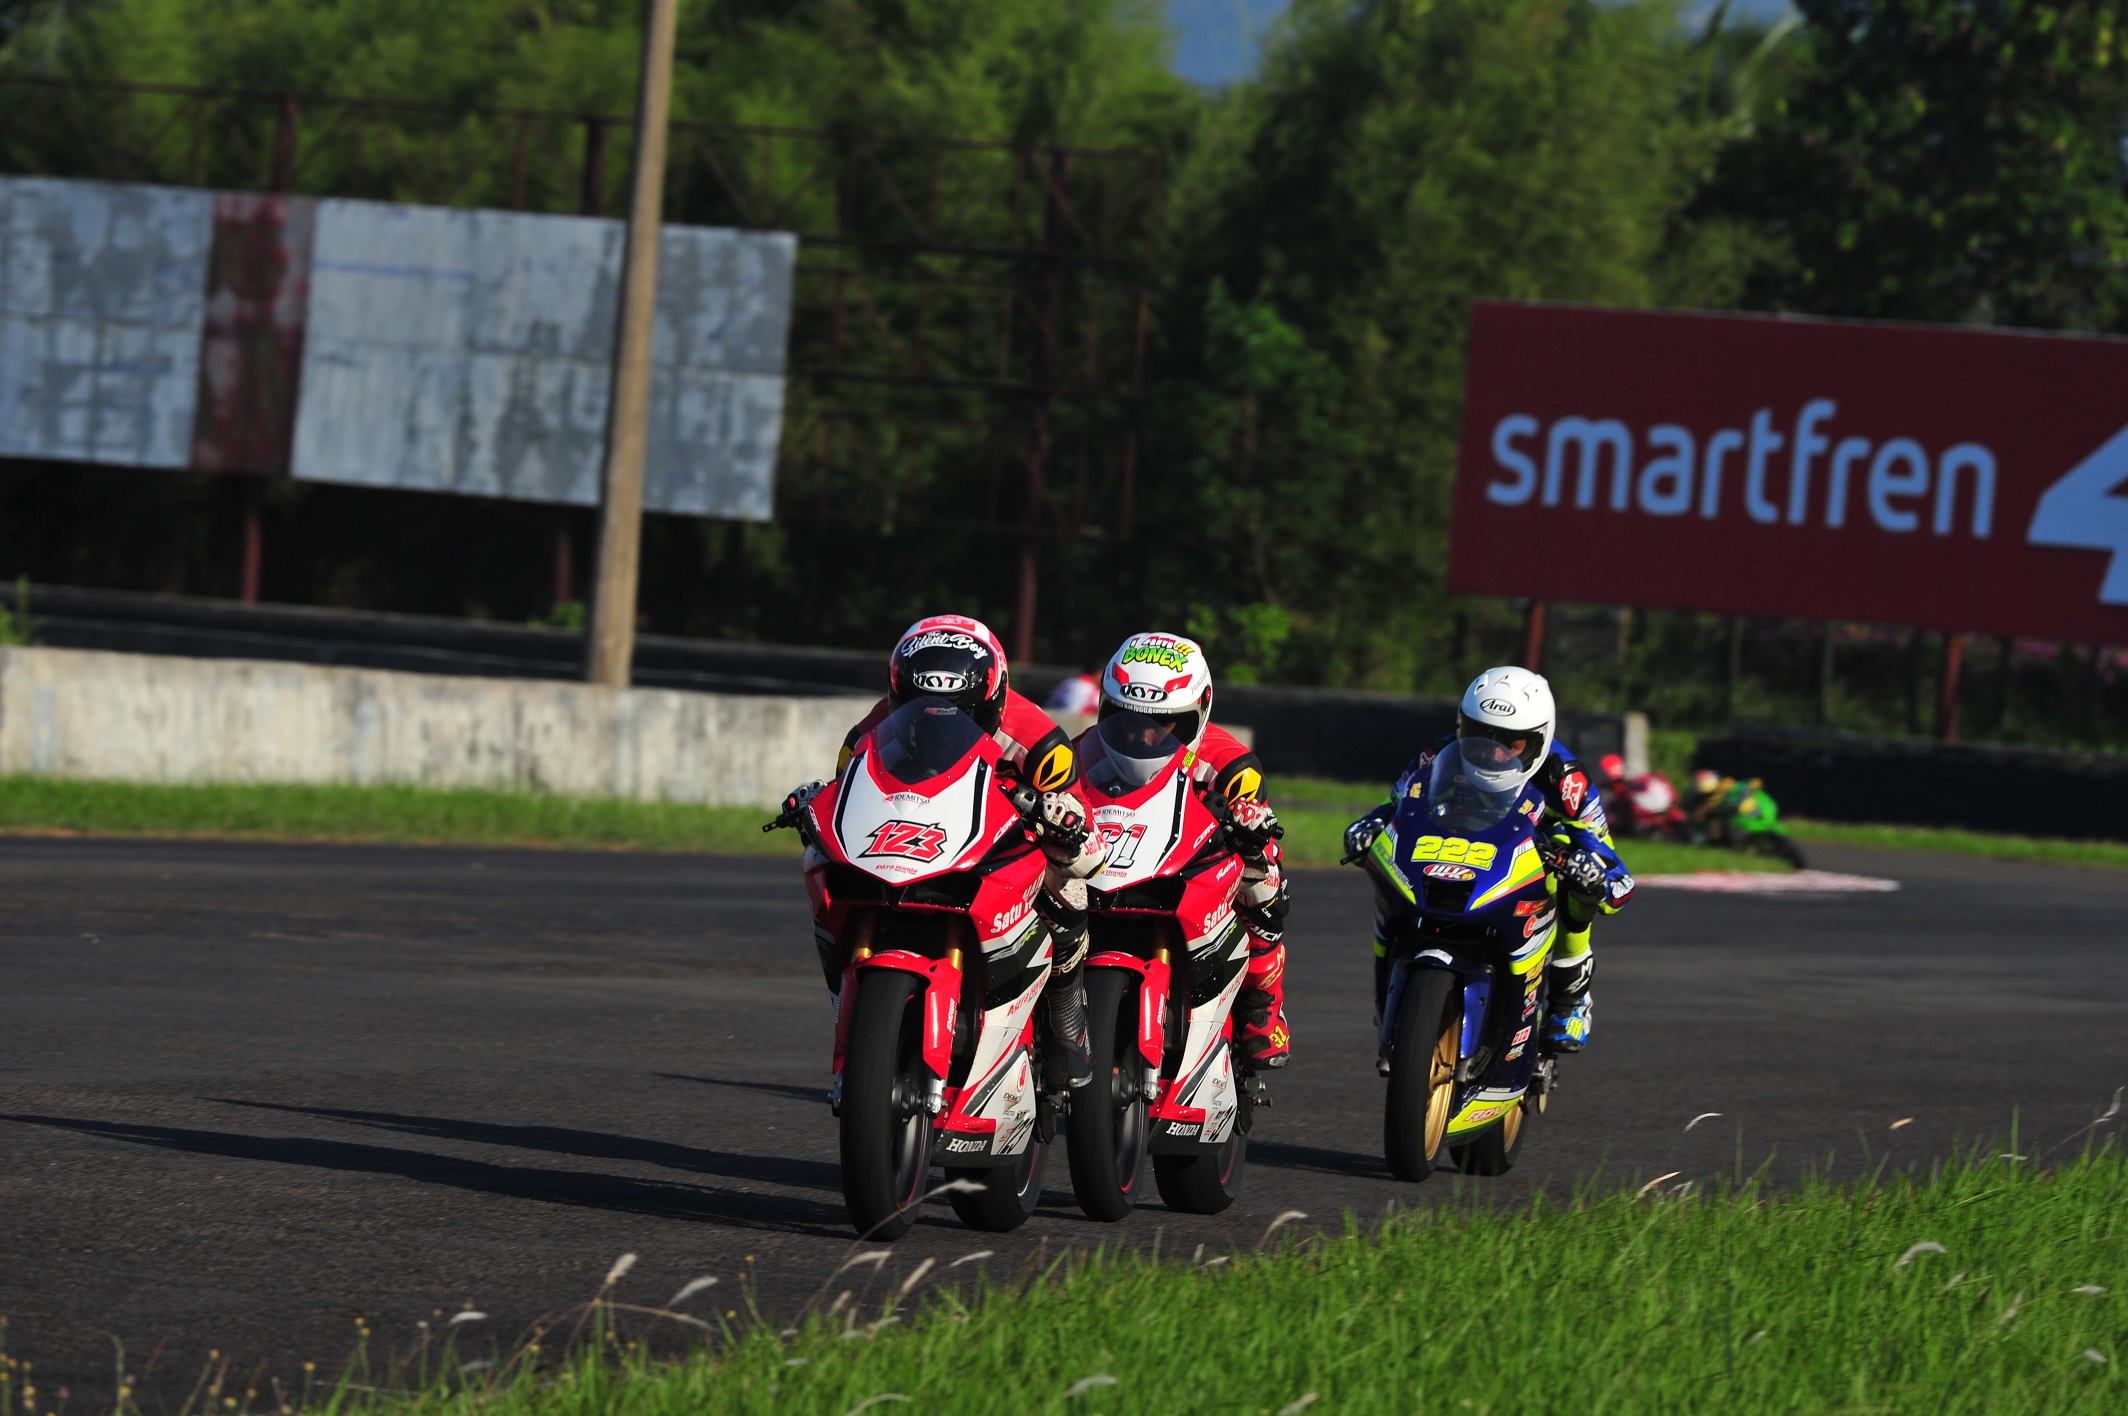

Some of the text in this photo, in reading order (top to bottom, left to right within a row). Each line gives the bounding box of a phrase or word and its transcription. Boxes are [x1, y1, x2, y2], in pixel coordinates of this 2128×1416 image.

[1487, 399, 1997, 538] smartfren
[950, 633, 988, 660] Boy
[1121, 646, 1188, 673] BONEX
[919, 676, 959, 689] KYT
[1127, 686, 1161, 700] KYT
[1485, 700, 1512, 713] Arai
[894, 793, 931, 805] IDEMITSU
[1102, 808, 1135, 818] IDEMITSU
[993, 814, 1018, 843] CBR
[1193, 822, 1216, 849] CBR
[861, 820, 946, 863] 123
[1411, 836, 1497, 871] 222
[895, 864, 918, 873] Honda
[991, 901, 1023, 934] Satu
[1203, 902, 1227, 934] Satu
[1268, 1025, 1287, 1049] 31
[1165, 1121, 1201, 1137] HONDA
[945, 1137, 987, 1153] HONDA
